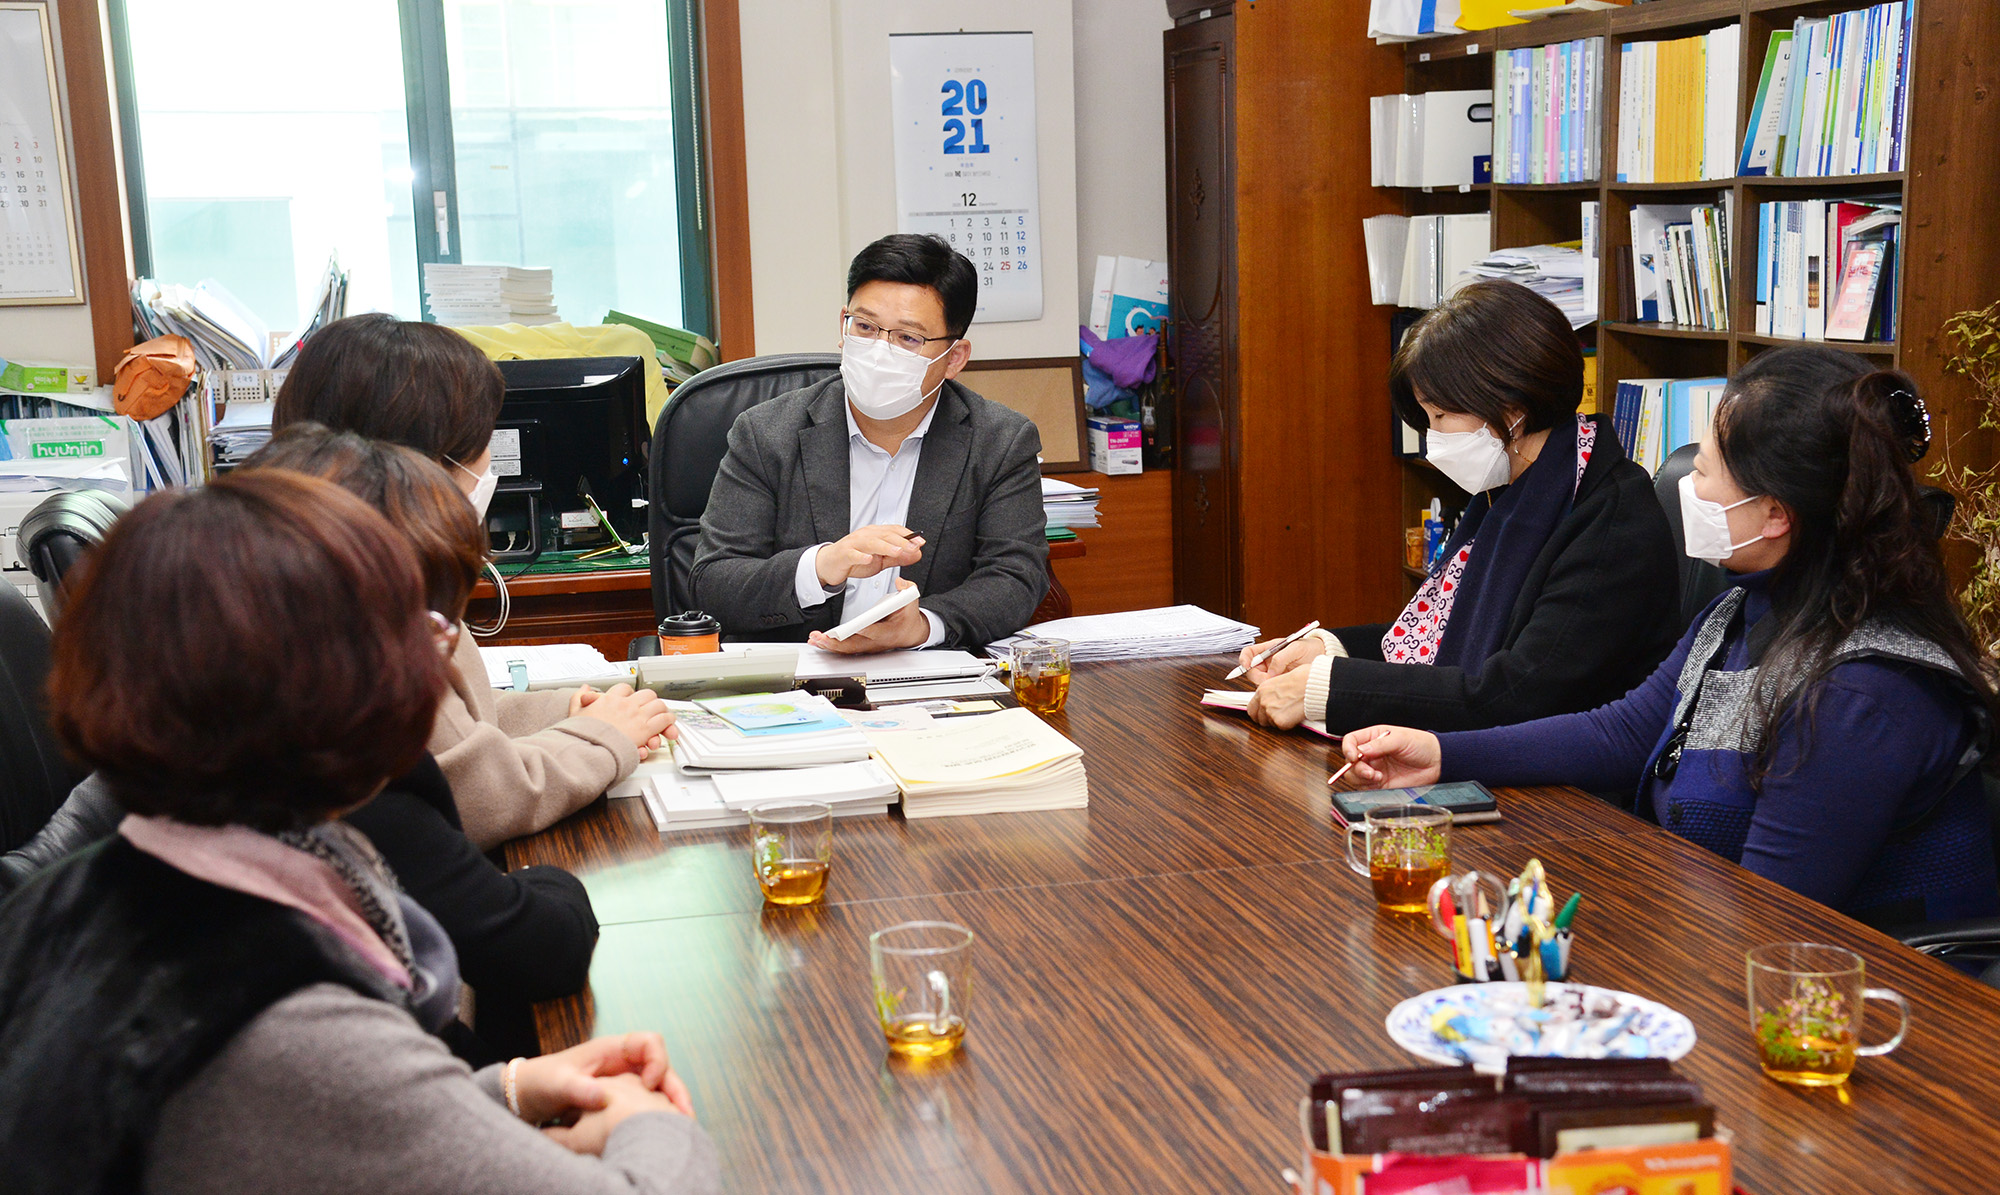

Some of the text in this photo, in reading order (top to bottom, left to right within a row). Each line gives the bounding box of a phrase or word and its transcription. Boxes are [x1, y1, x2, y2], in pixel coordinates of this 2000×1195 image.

[941, 79, 987, 116] 20
[943, 118, 990, 154] 21
[961, 193, 977, 207] 12
[967, 218, 972, 227] 2
[984, 217, 990, 226] 3
[1001, 217, 1007, 225] 4
[1018, 216, 1024, 225] 5
[950, 231, 1026, 242] 8 9 10 11 12
[966, 246, 1026, 257] 16 17 18 19
[983, 261, 1028, 272] 24 25 26
[983, 277, 993, 286] 31
[36, 442, 99, 458] hyunjin
